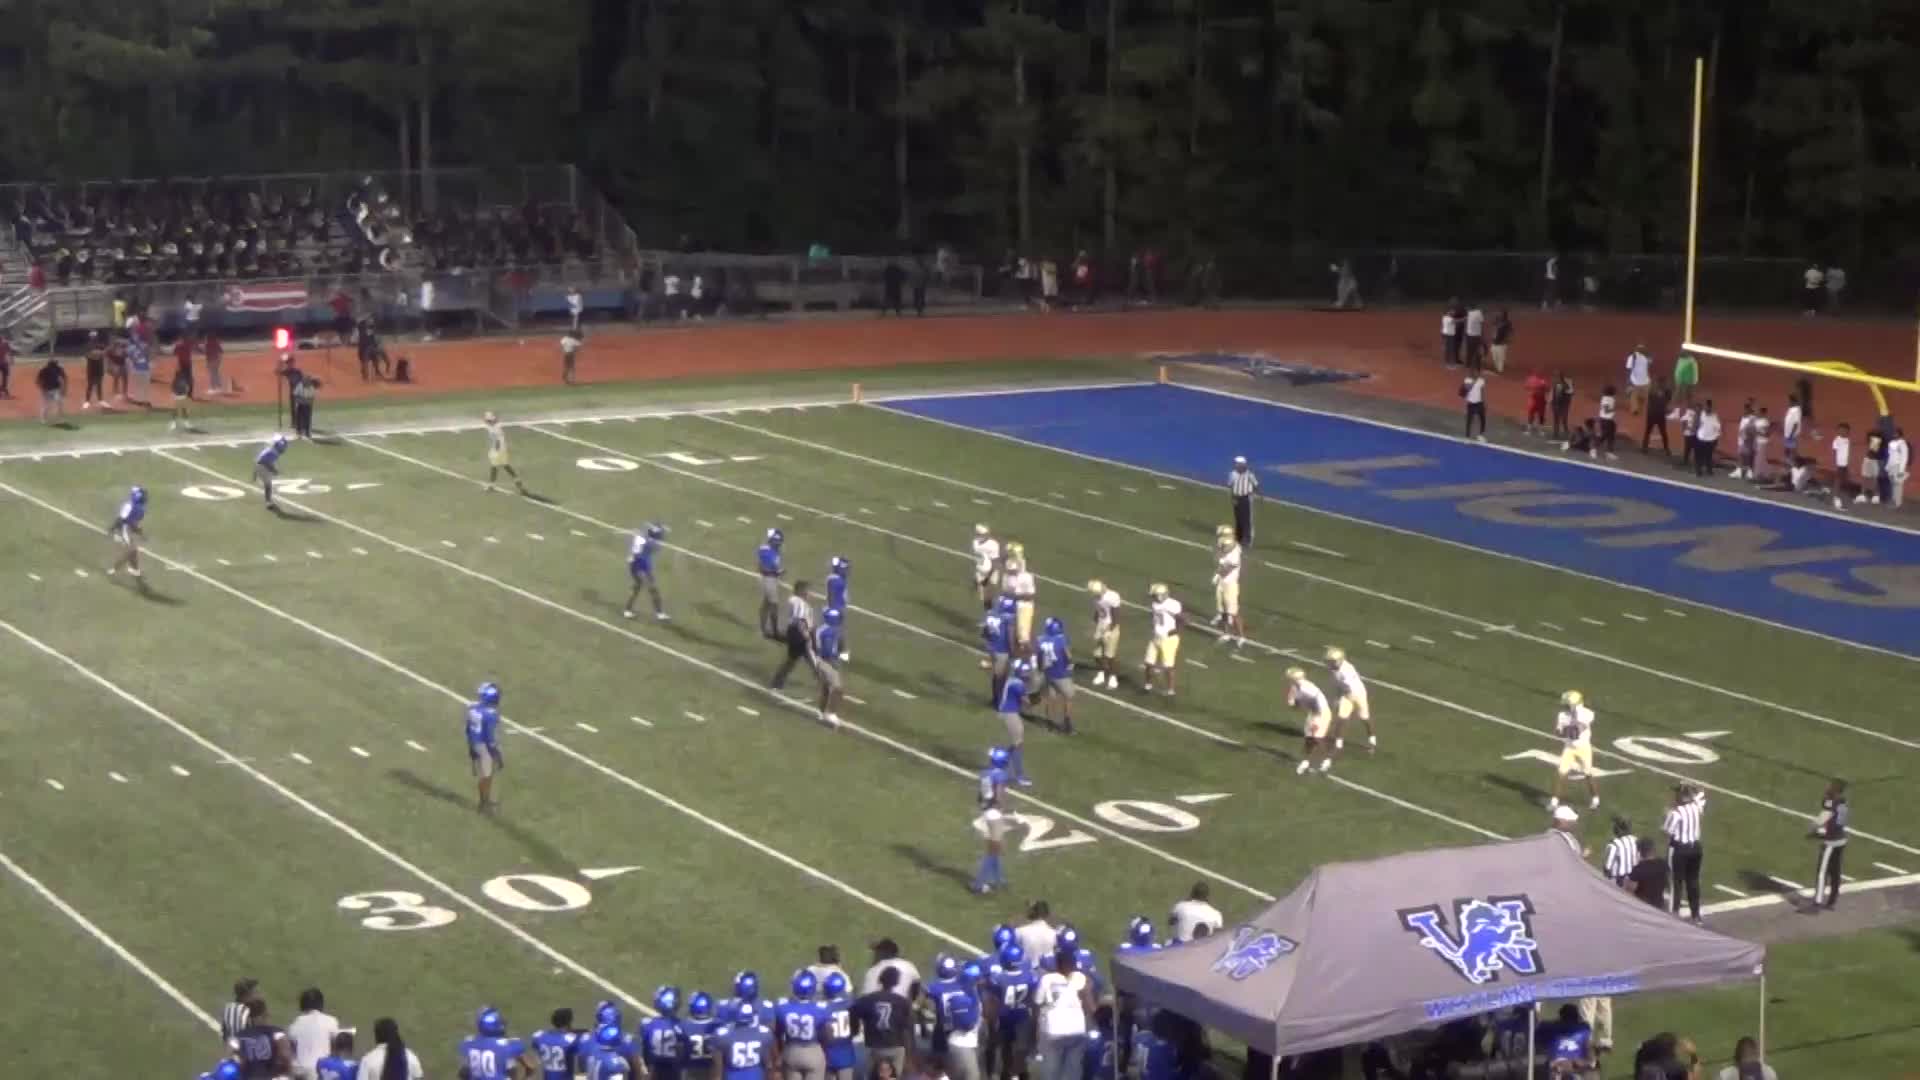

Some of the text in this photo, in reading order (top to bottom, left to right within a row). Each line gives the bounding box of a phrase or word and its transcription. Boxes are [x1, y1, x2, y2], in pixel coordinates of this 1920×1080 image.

[1264, 454, 1920, 608] LIONS
[972, 800, 1200, 851] 20
[337, 874, 592, 930] 30
[785, 1011, 815, 1041] 63
